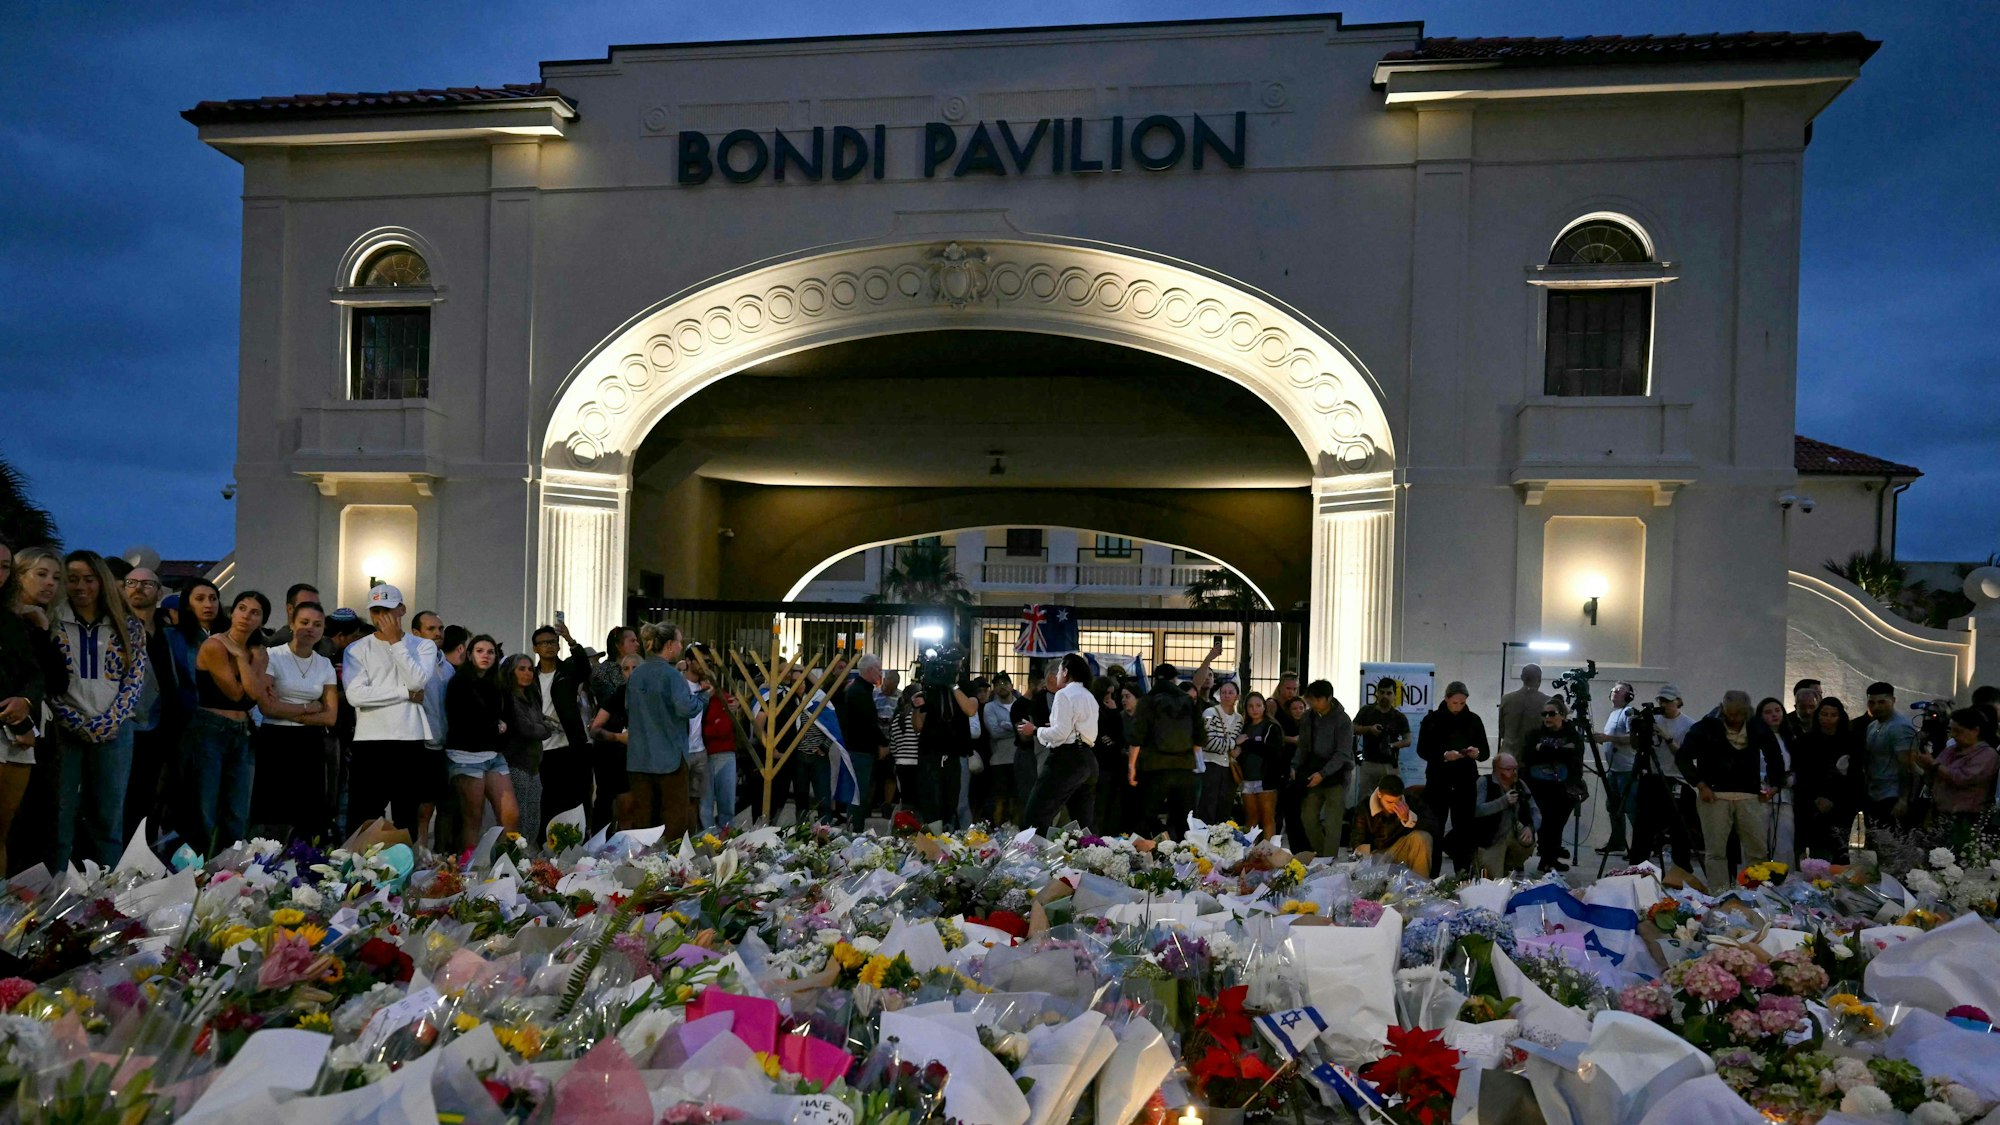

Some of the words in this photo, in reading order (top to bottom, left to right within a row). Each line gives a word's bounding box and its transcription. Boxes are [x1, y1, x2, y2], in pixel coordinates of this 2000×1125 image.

[678, 124, 886, 185] BONDI
[924, 111, 1247, 178] PAVILION
[1366, 683, 1428, 706] BNDI
